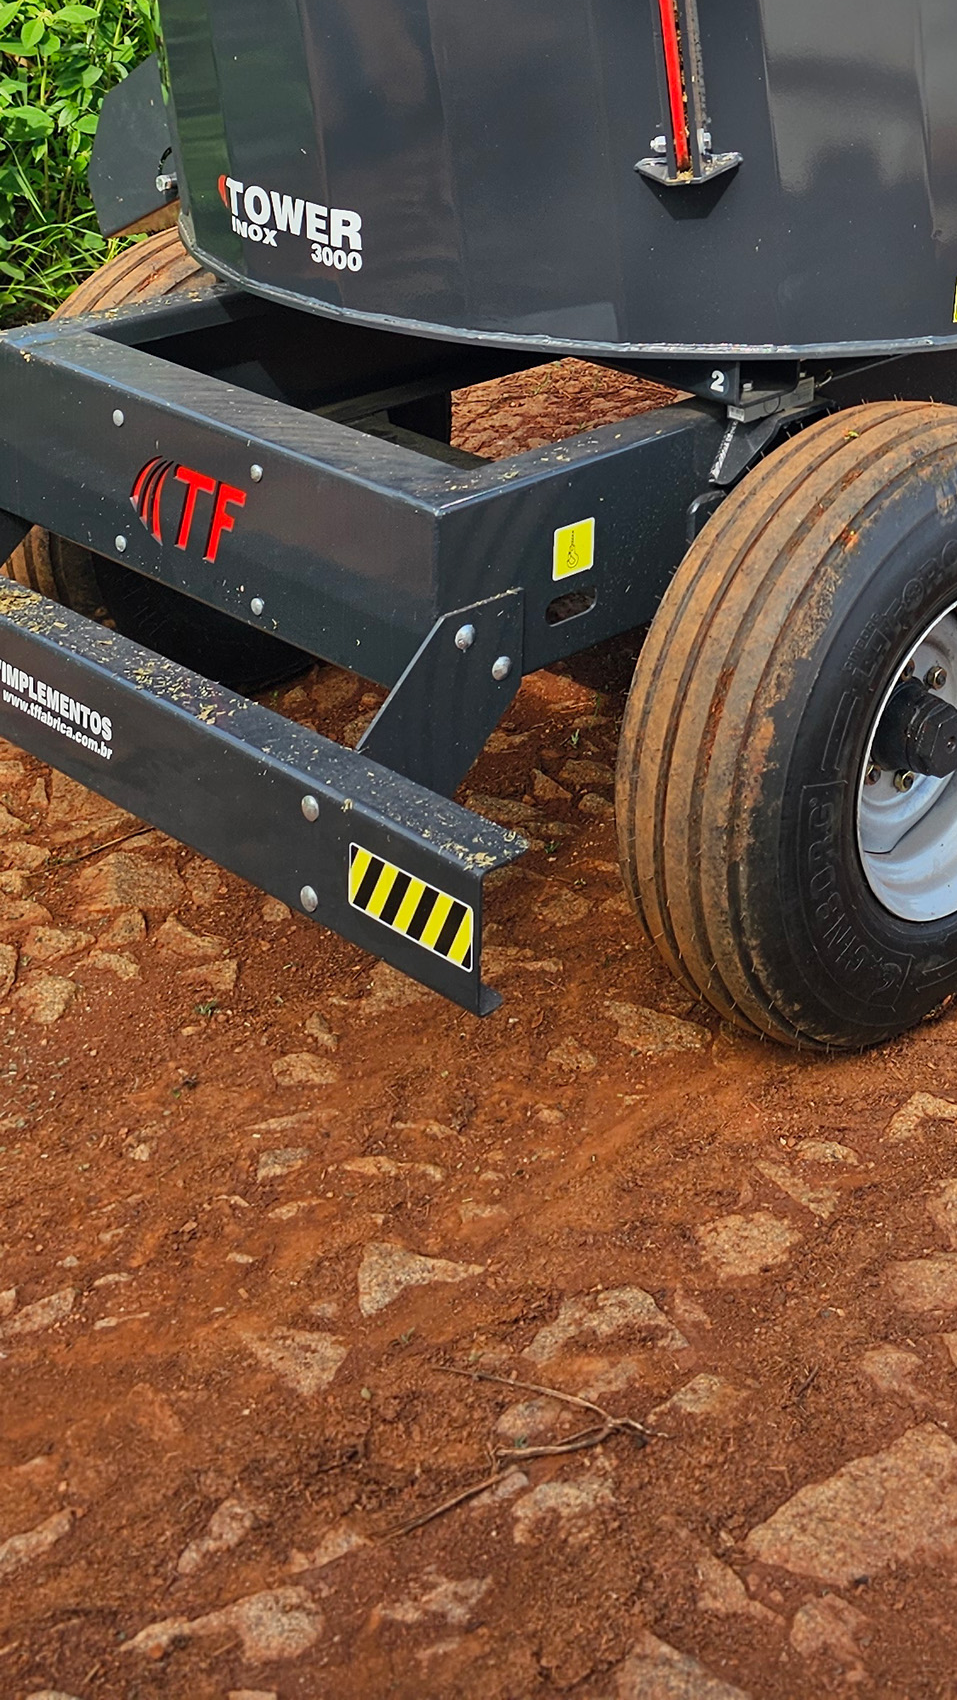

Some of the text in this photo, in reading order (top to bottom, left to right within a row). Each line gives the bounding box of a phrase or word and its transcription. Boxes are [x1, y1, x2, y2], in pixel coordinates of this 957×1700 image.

[226, 177, 363, 250] TOWER
[231, 216, 363, 272] INOX 3000
[710, 370, 725, 393] 2
[174, 464, 247, 564] TF
[2, 663, 113, 741] IMPLEMENTOS
[2, 689, 113, 760] www.tffabrica.com.br
